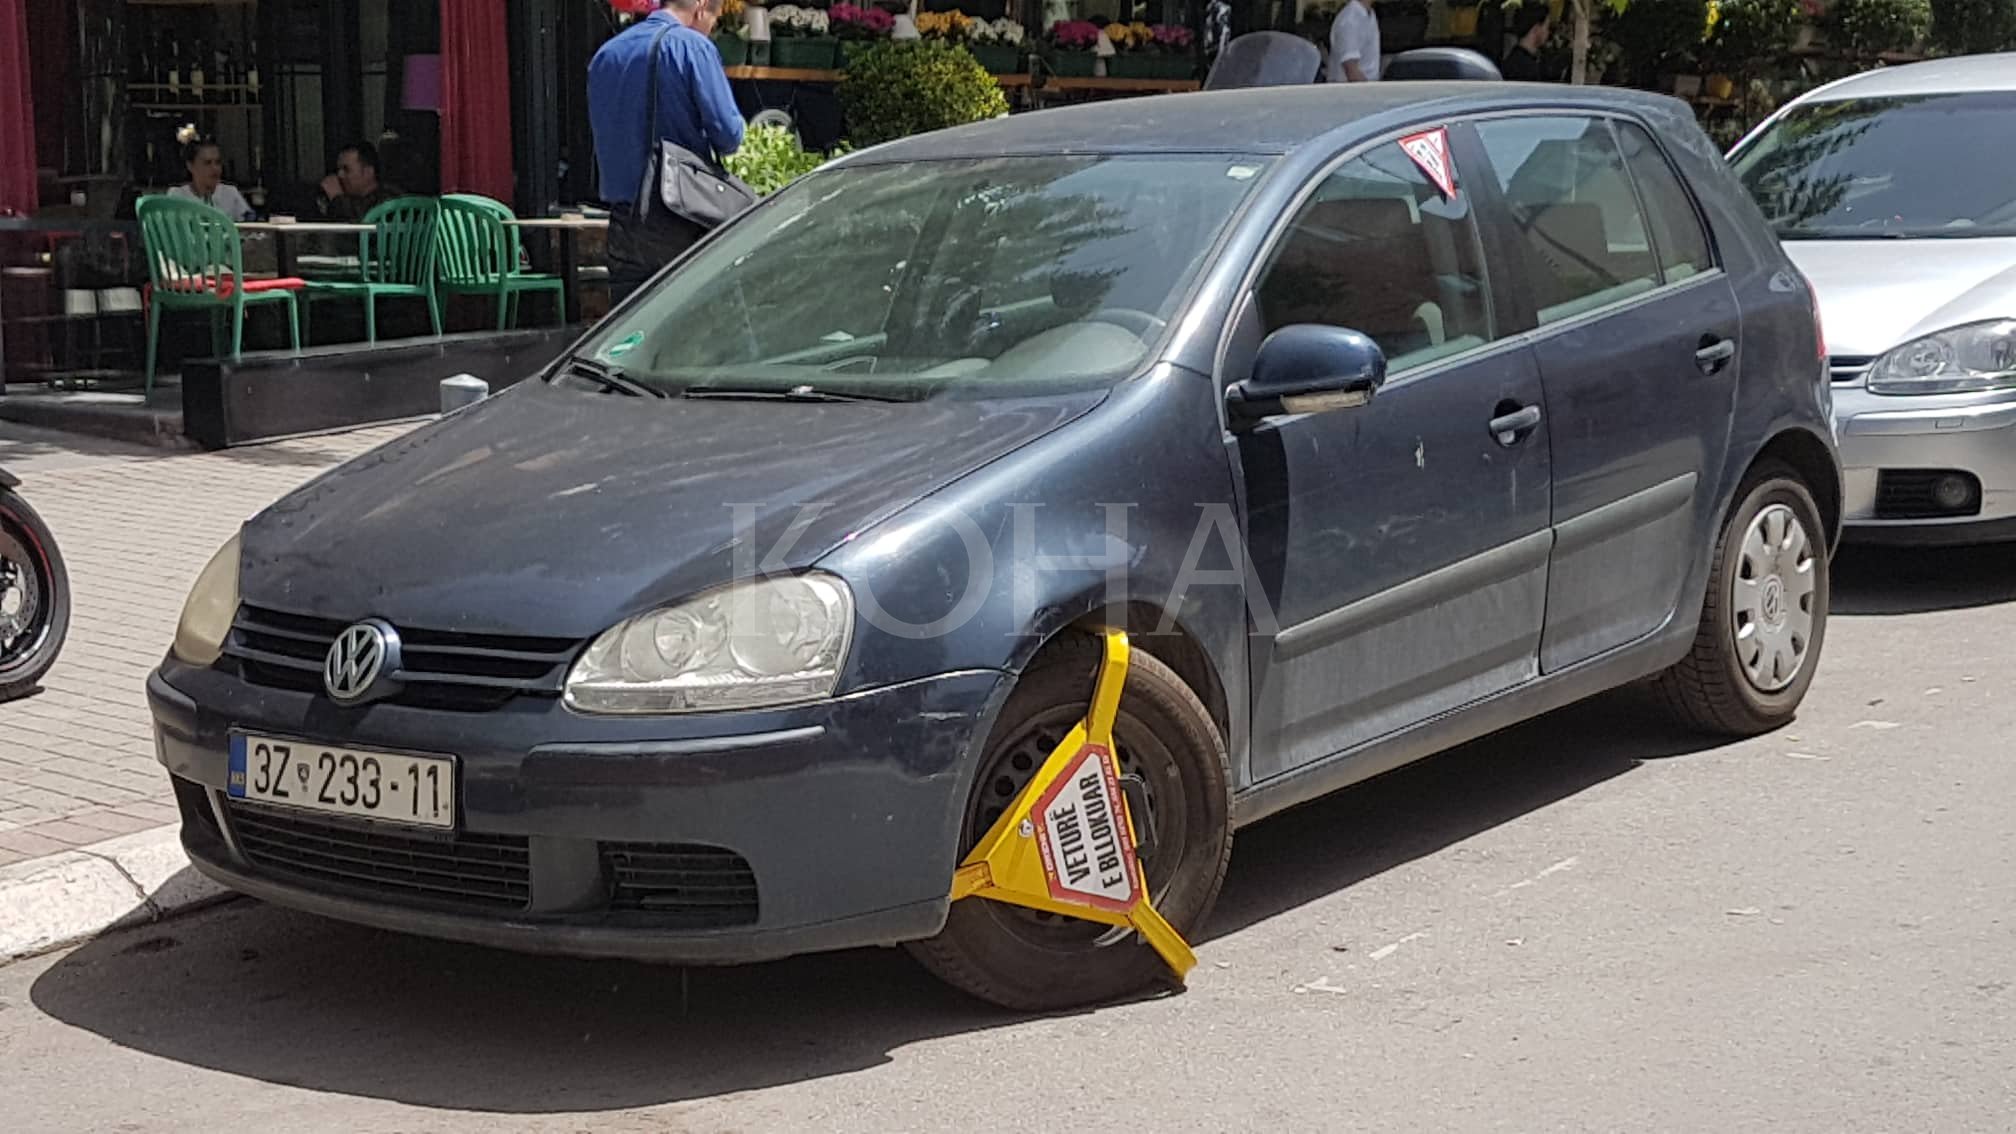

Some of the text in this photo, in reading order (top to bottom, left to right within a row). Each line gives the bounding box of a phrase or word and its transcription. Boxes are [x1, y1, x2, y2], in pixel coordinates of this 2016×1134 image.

[325, 625, 384, 698] VW
[254, 743, 291, 798] 3Z
[1050, 802, 1090, 885] VETURË
[1080, 772, 1120, 873] BLLOKUAR
[1102, 871, 1123, 889] E
